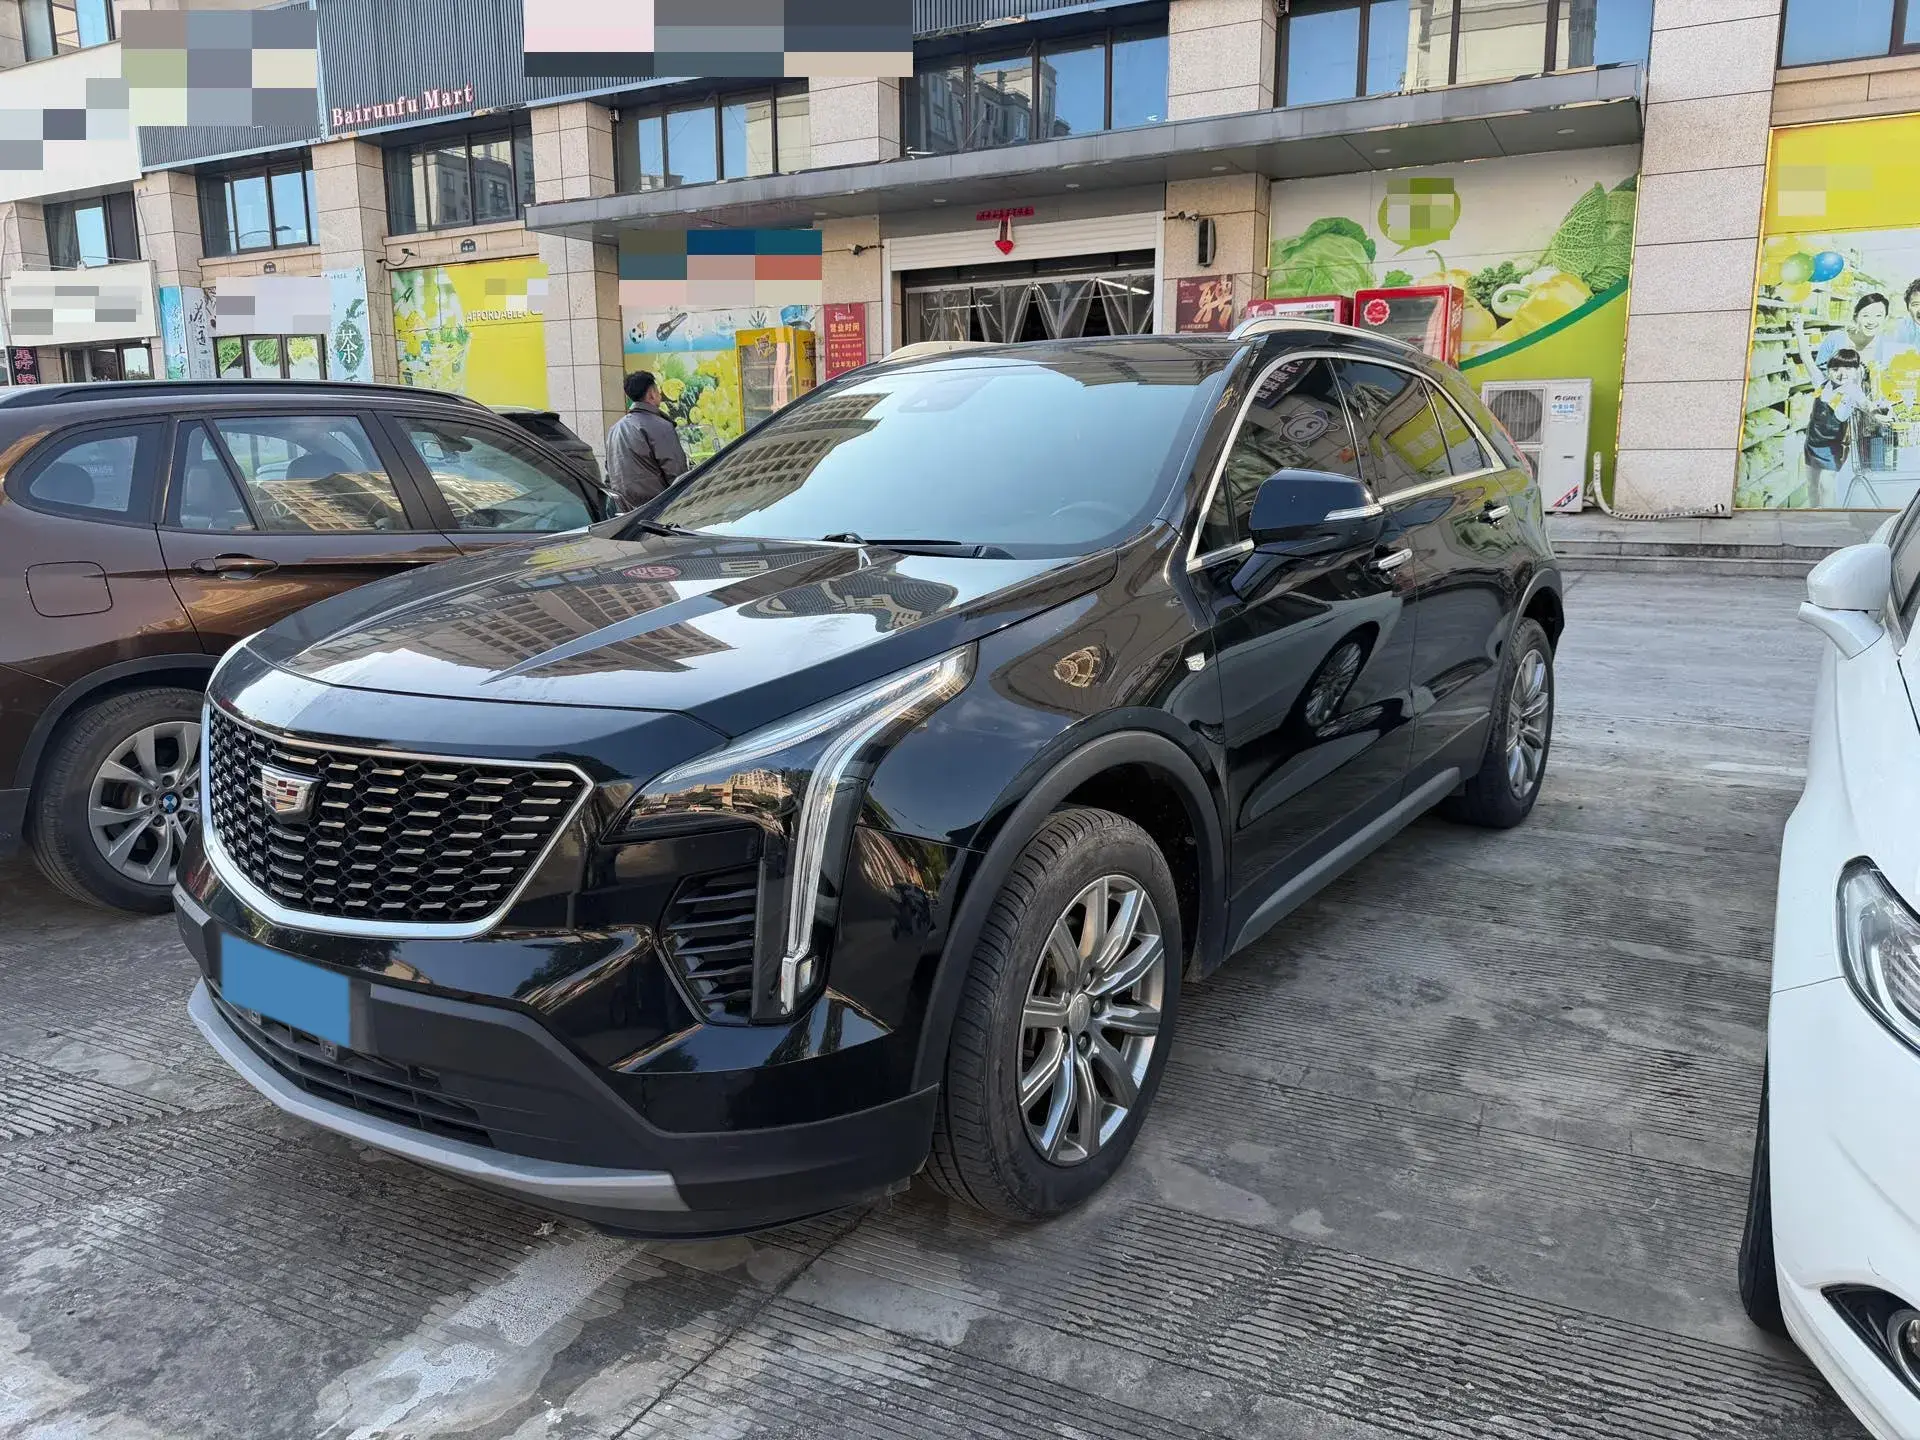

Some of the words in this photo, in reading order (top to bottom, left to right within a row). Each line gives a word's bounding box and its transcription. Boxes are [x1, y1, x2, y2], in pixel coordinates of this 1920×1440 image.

[332, 96, 418, 127] Bairunfu
[424, 81, 474, 111] Mart
[466, 311, 522, 322] AFFORDABLE
[338, 330, 358, 363] 茶
